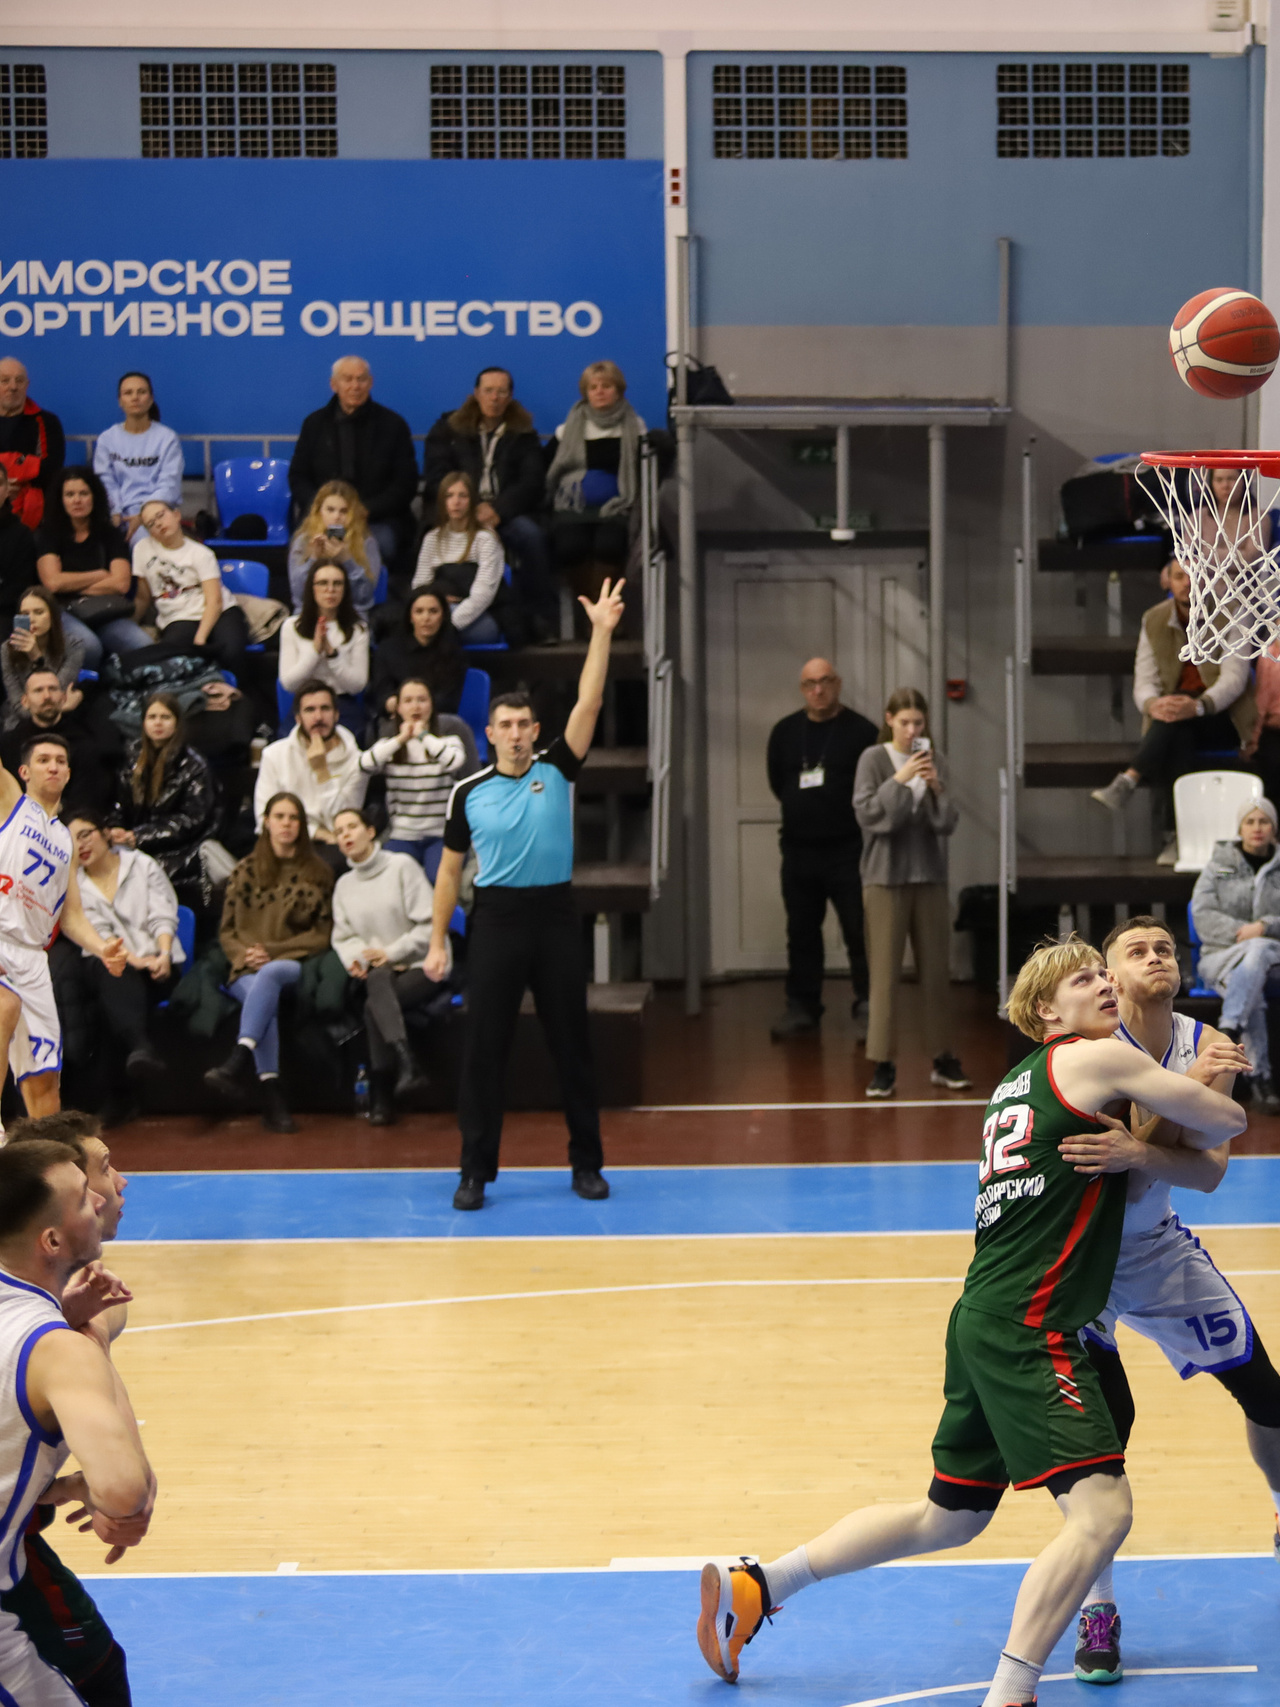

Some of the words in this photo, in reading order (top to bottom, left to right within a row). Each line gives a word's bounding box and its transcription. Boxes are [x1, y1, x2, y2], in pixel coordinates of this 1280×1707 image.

[0, 259, 292, 295] ИМОРСКОЕ
[0, 300, 285, 337] ОРТИВНОЕ
[300, 300, 603, 342] ОБЩЕСТВО
[23, 848, 56, 887] 77
[28, 1034, 56, 1062] 77
[979, 1103, 1034, 1184] 32
[1184, 1310, 1238, 1351] 15
